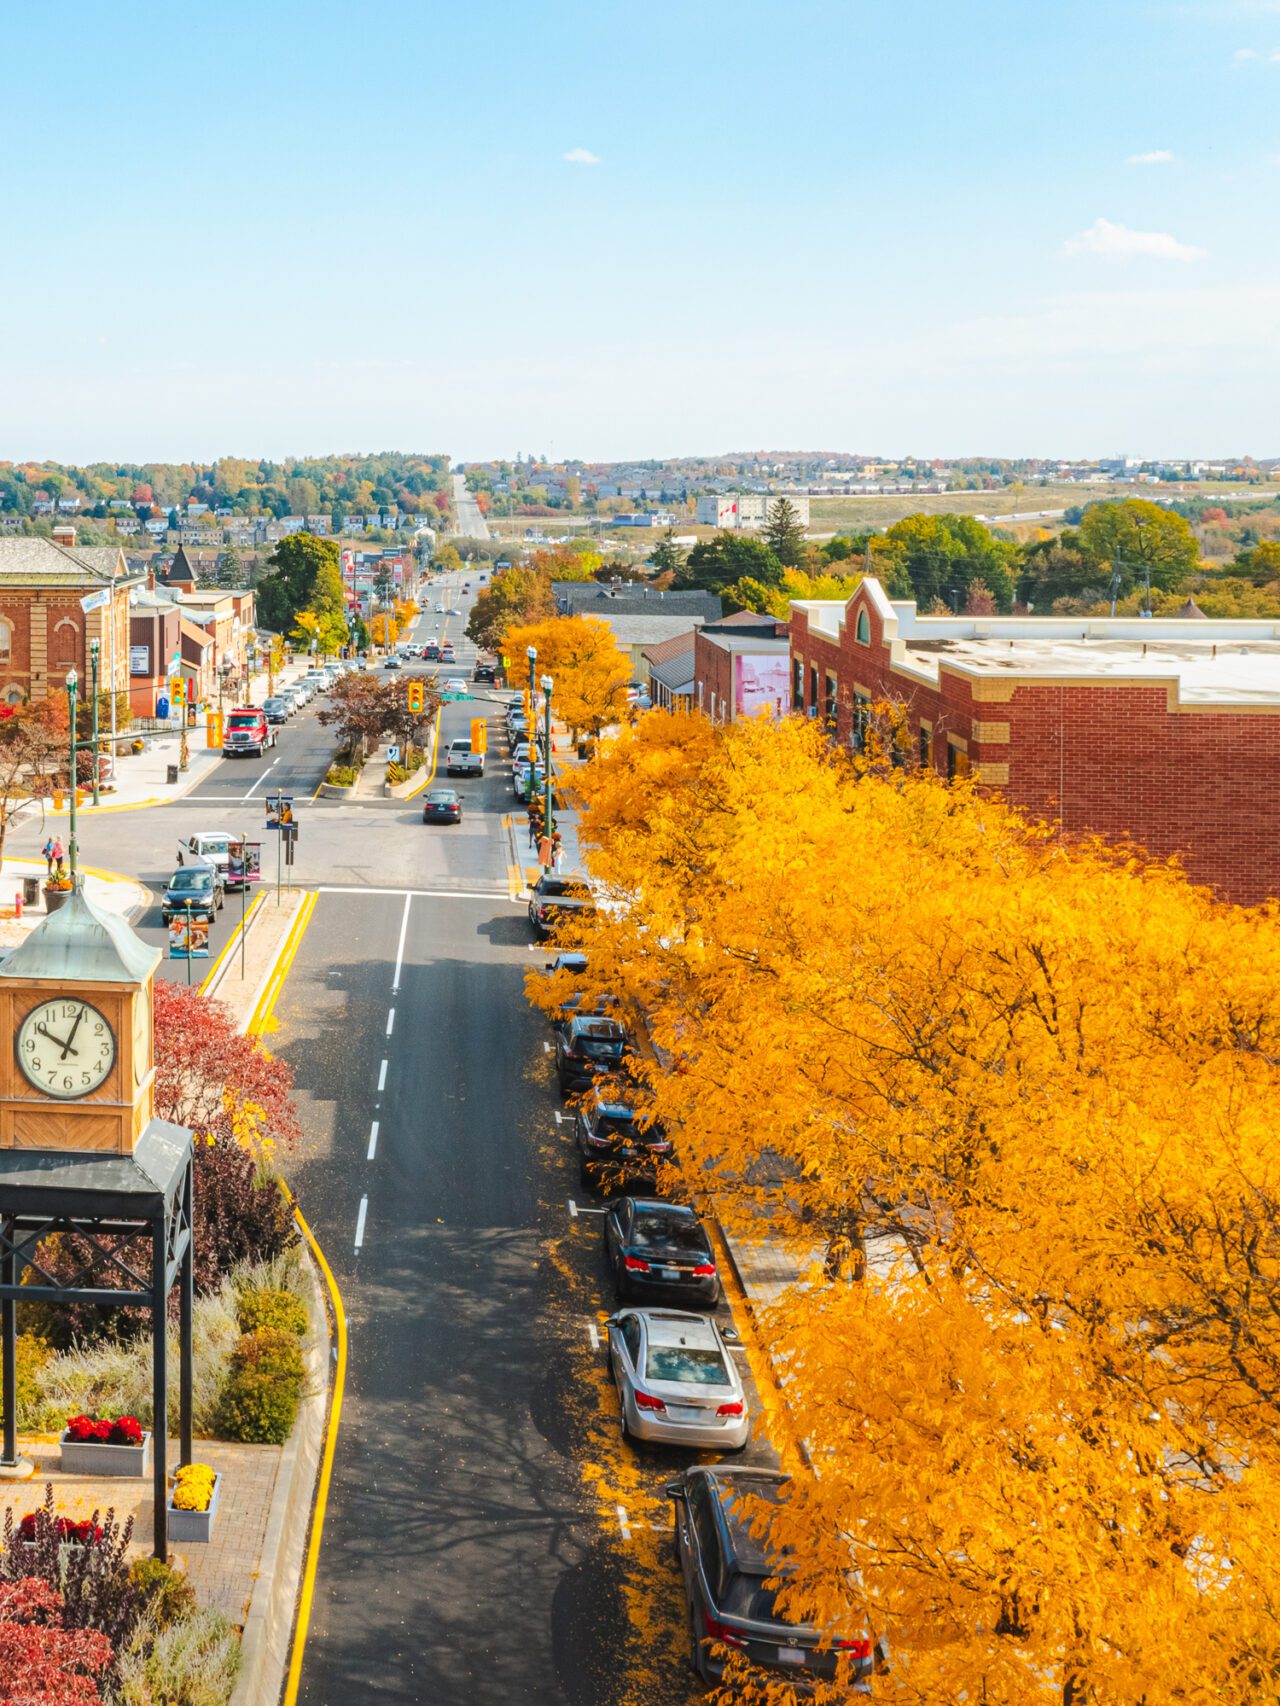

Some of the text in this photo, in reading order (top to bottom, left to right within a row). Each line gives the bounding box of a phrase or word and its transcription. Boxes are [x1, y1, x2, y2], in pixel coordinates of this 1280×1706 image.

[46, 1009, 56, 1023] 11
[62, 1004, 77, 1019] 12
[84, 1009, 89, 1023] 1
[33, 1021, 47, 1035] 10
[94, 1023, 104, 1037] 2
[25, 1039, 36, 1053] 9
[100, 1042, 110, 1056] 3
[31, 1057, 41, 1071] 8
[93, 1059, 104, 1073] 4
[47, 1070, 58, 1085] 7
[63, 1075, 73, 1090] 6
[81, 1071, 91, 1085] 5
